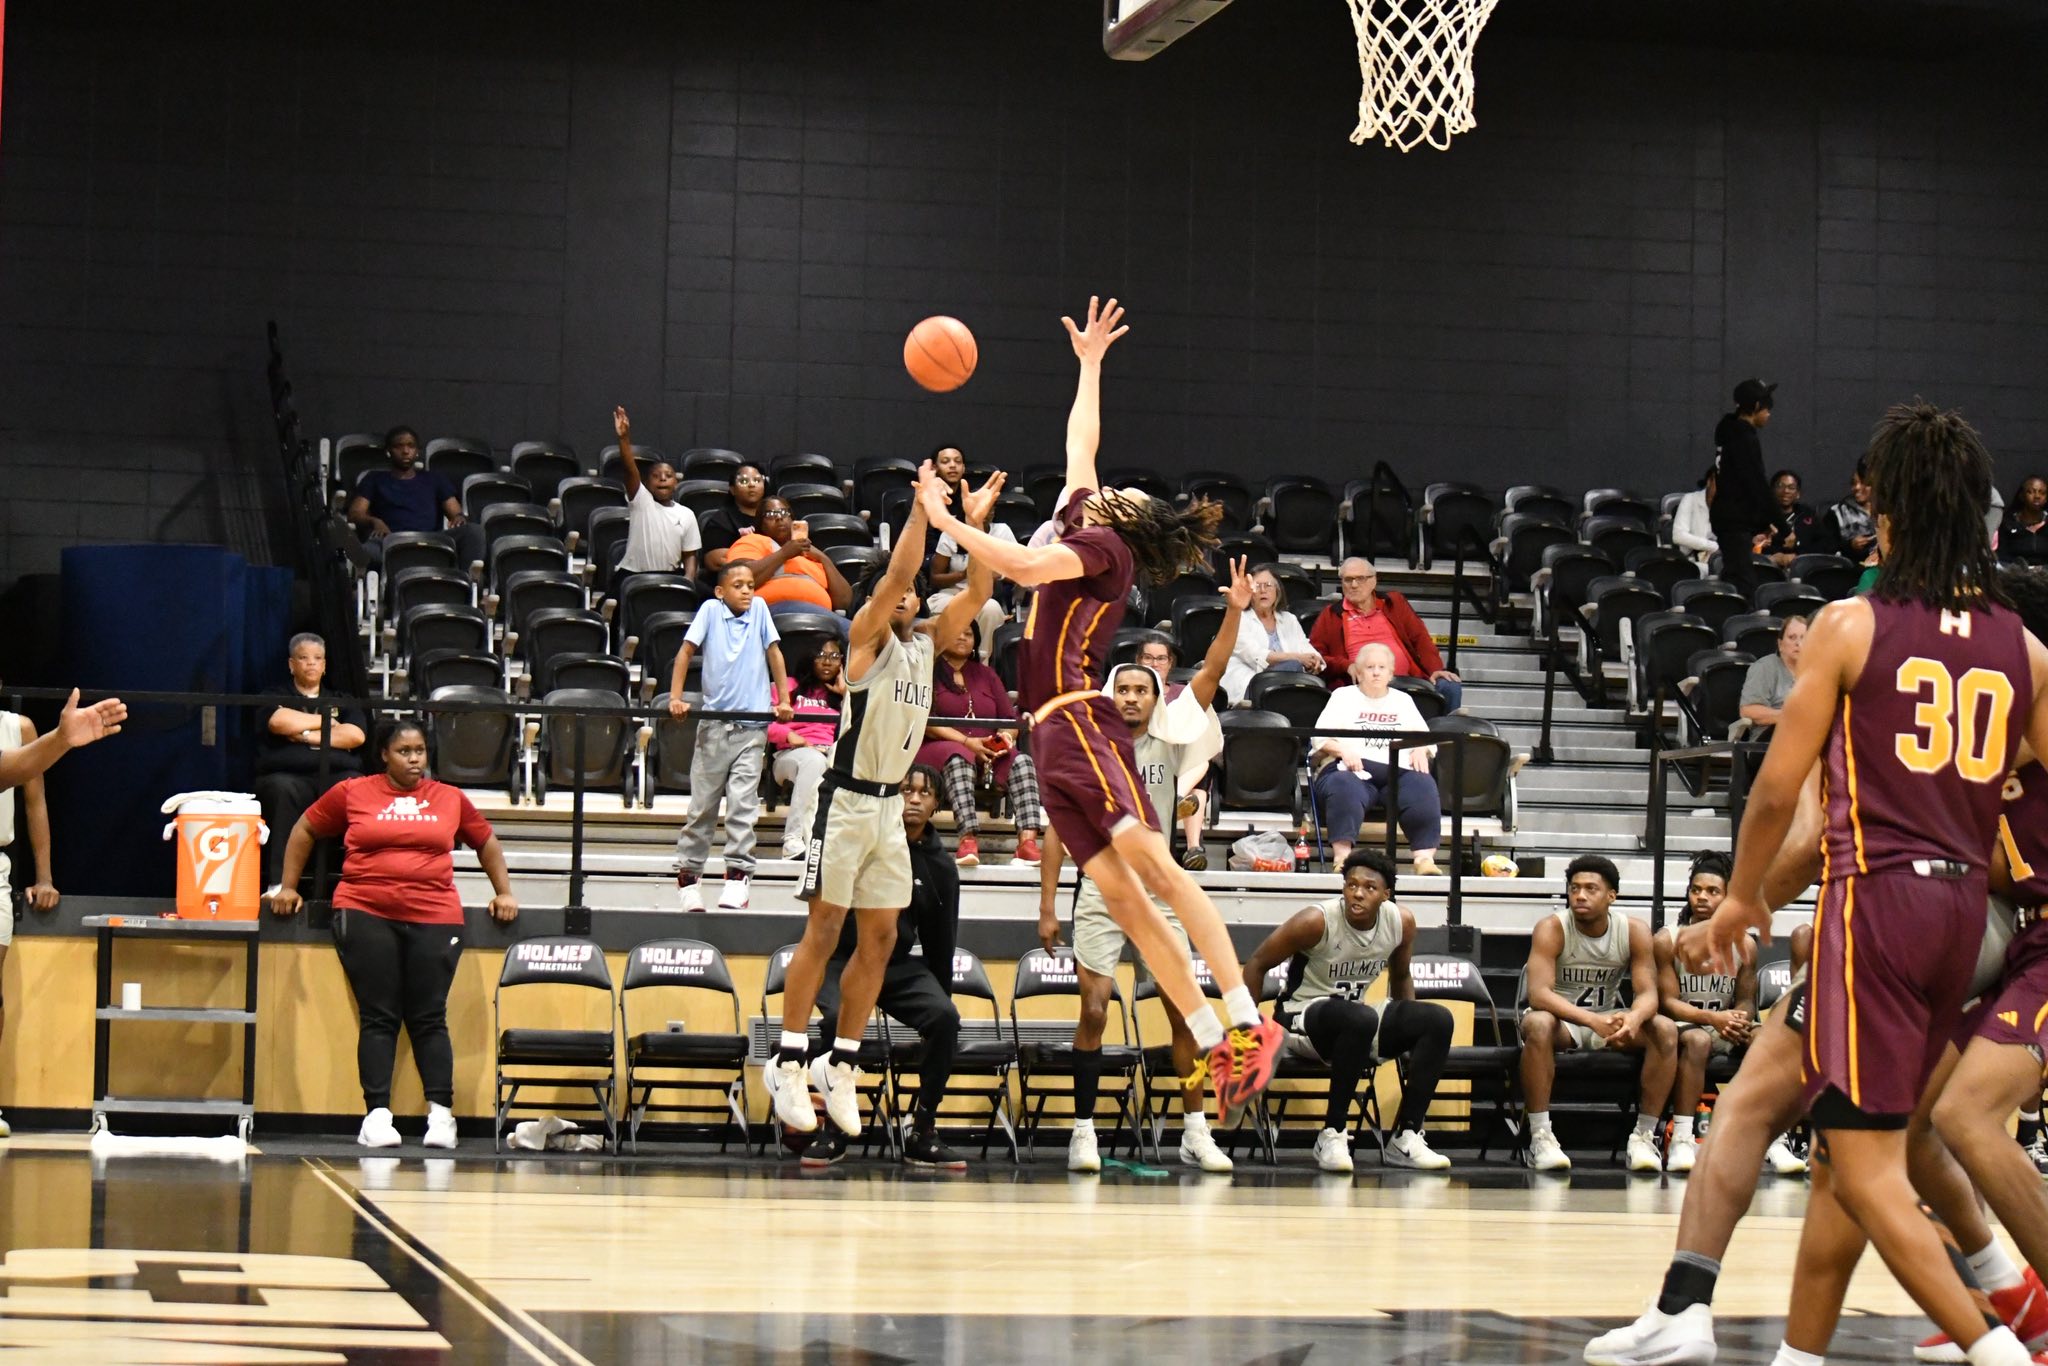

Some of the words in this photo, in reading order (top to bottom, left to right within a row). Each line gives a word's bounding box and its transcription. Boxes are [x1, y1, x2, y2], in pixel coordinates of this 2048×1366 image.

[1359, 711, 1398, 723] DOGS
[1895, 656, 2015, 784] 30
[200, 828, 229, 861] G
[806, 838, 822, 890] BULLDOGS
[517, 944, 593, 962] HOLMES
[640, 947, 714, 965] HOLMES
[528, 961, 582, 971] BASKETBALL
[651, 965, 704, 975] BASKETBALL
[1680, 974, 1736, 995] HOLMES
[1575, 985, 1606, 1007] 21
